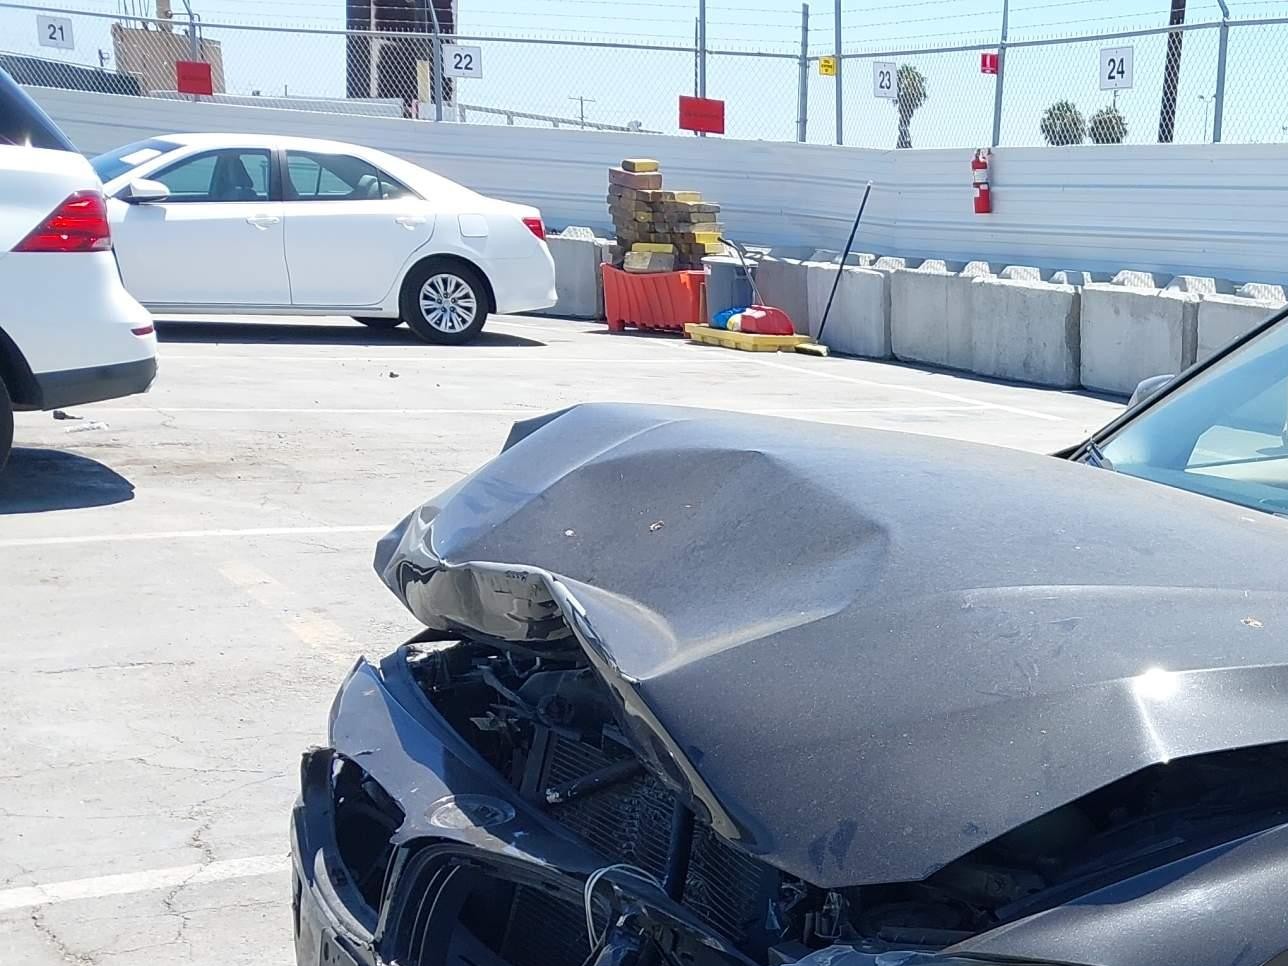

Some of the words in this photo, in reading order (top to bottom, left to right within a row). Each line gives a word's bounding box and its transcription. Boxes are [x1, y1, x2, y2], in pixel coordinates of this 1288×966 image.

[47, 23, 65, 41] 21
[453, 53, 473, 71] 22
[1107, 57, 1126, 80] 24
[878, 70, 892, 90] 23
